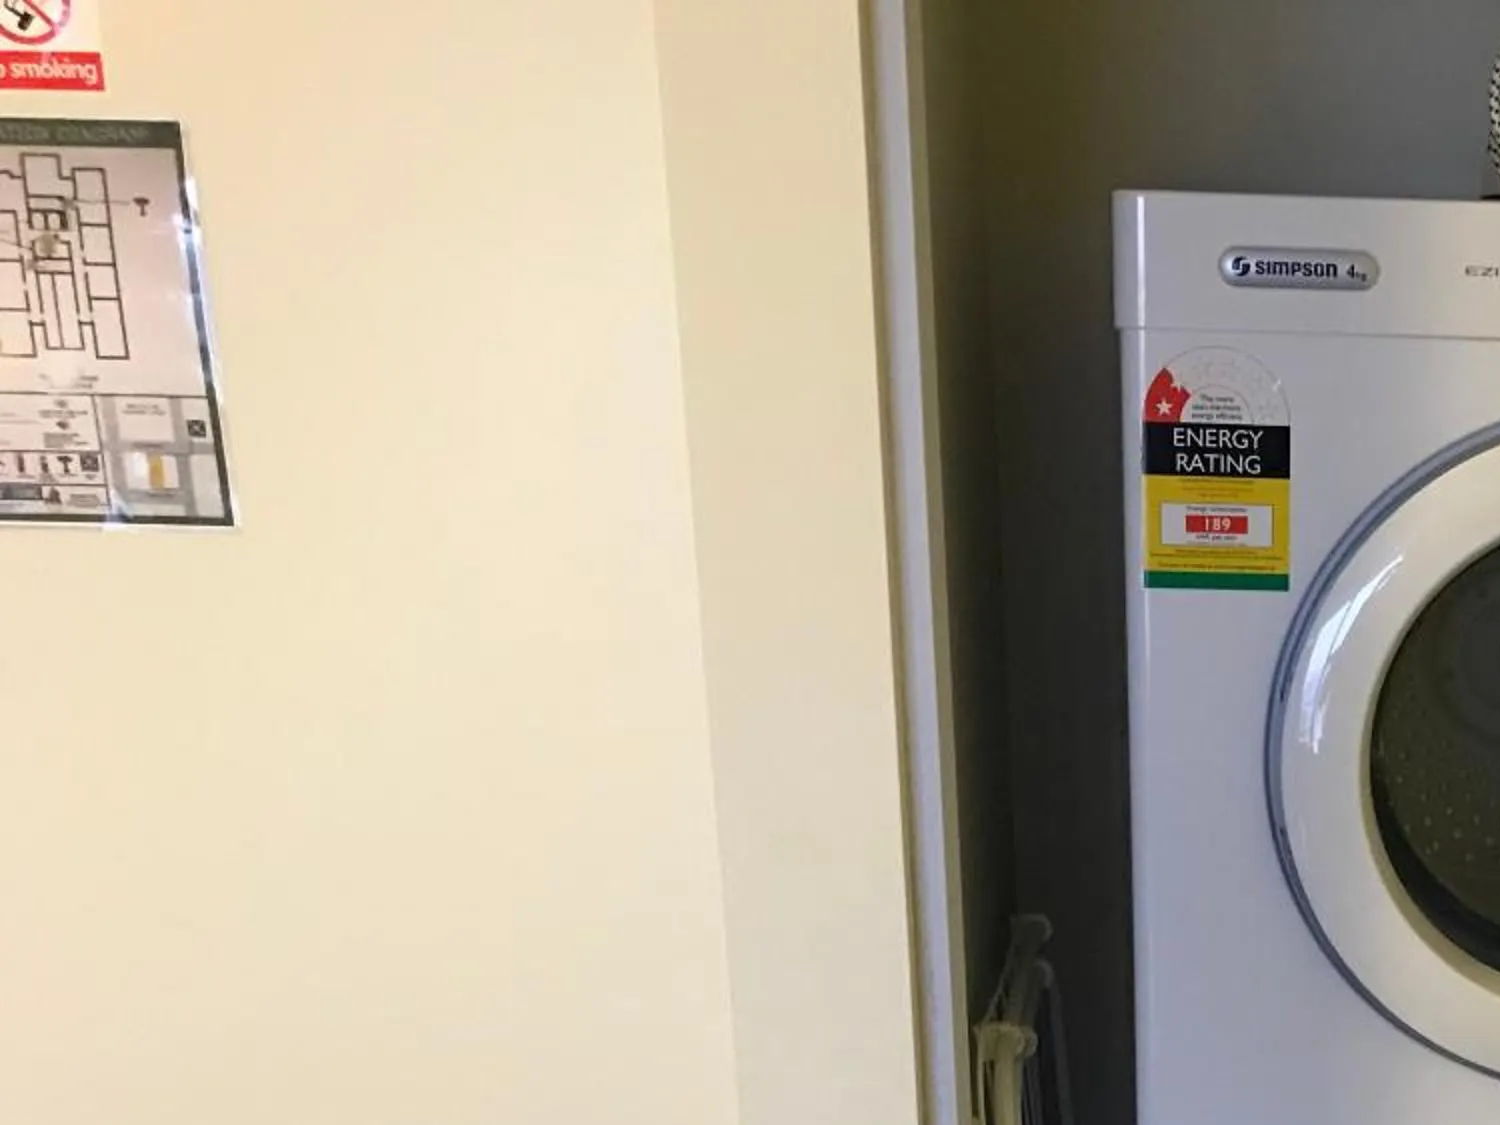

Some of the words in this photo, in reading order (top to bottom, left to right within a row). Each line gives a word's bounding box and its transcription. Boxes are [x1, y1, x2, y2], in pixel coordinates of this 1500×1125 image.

[10, 57, 99, 85] smoking
[1255, 260, 1338, 278] SIMPSON
[1173, 427, 1263, 449] ENERGY
[1175, 453, 1262, 474] RATING
[1204, 517, 1231, 531] 189
